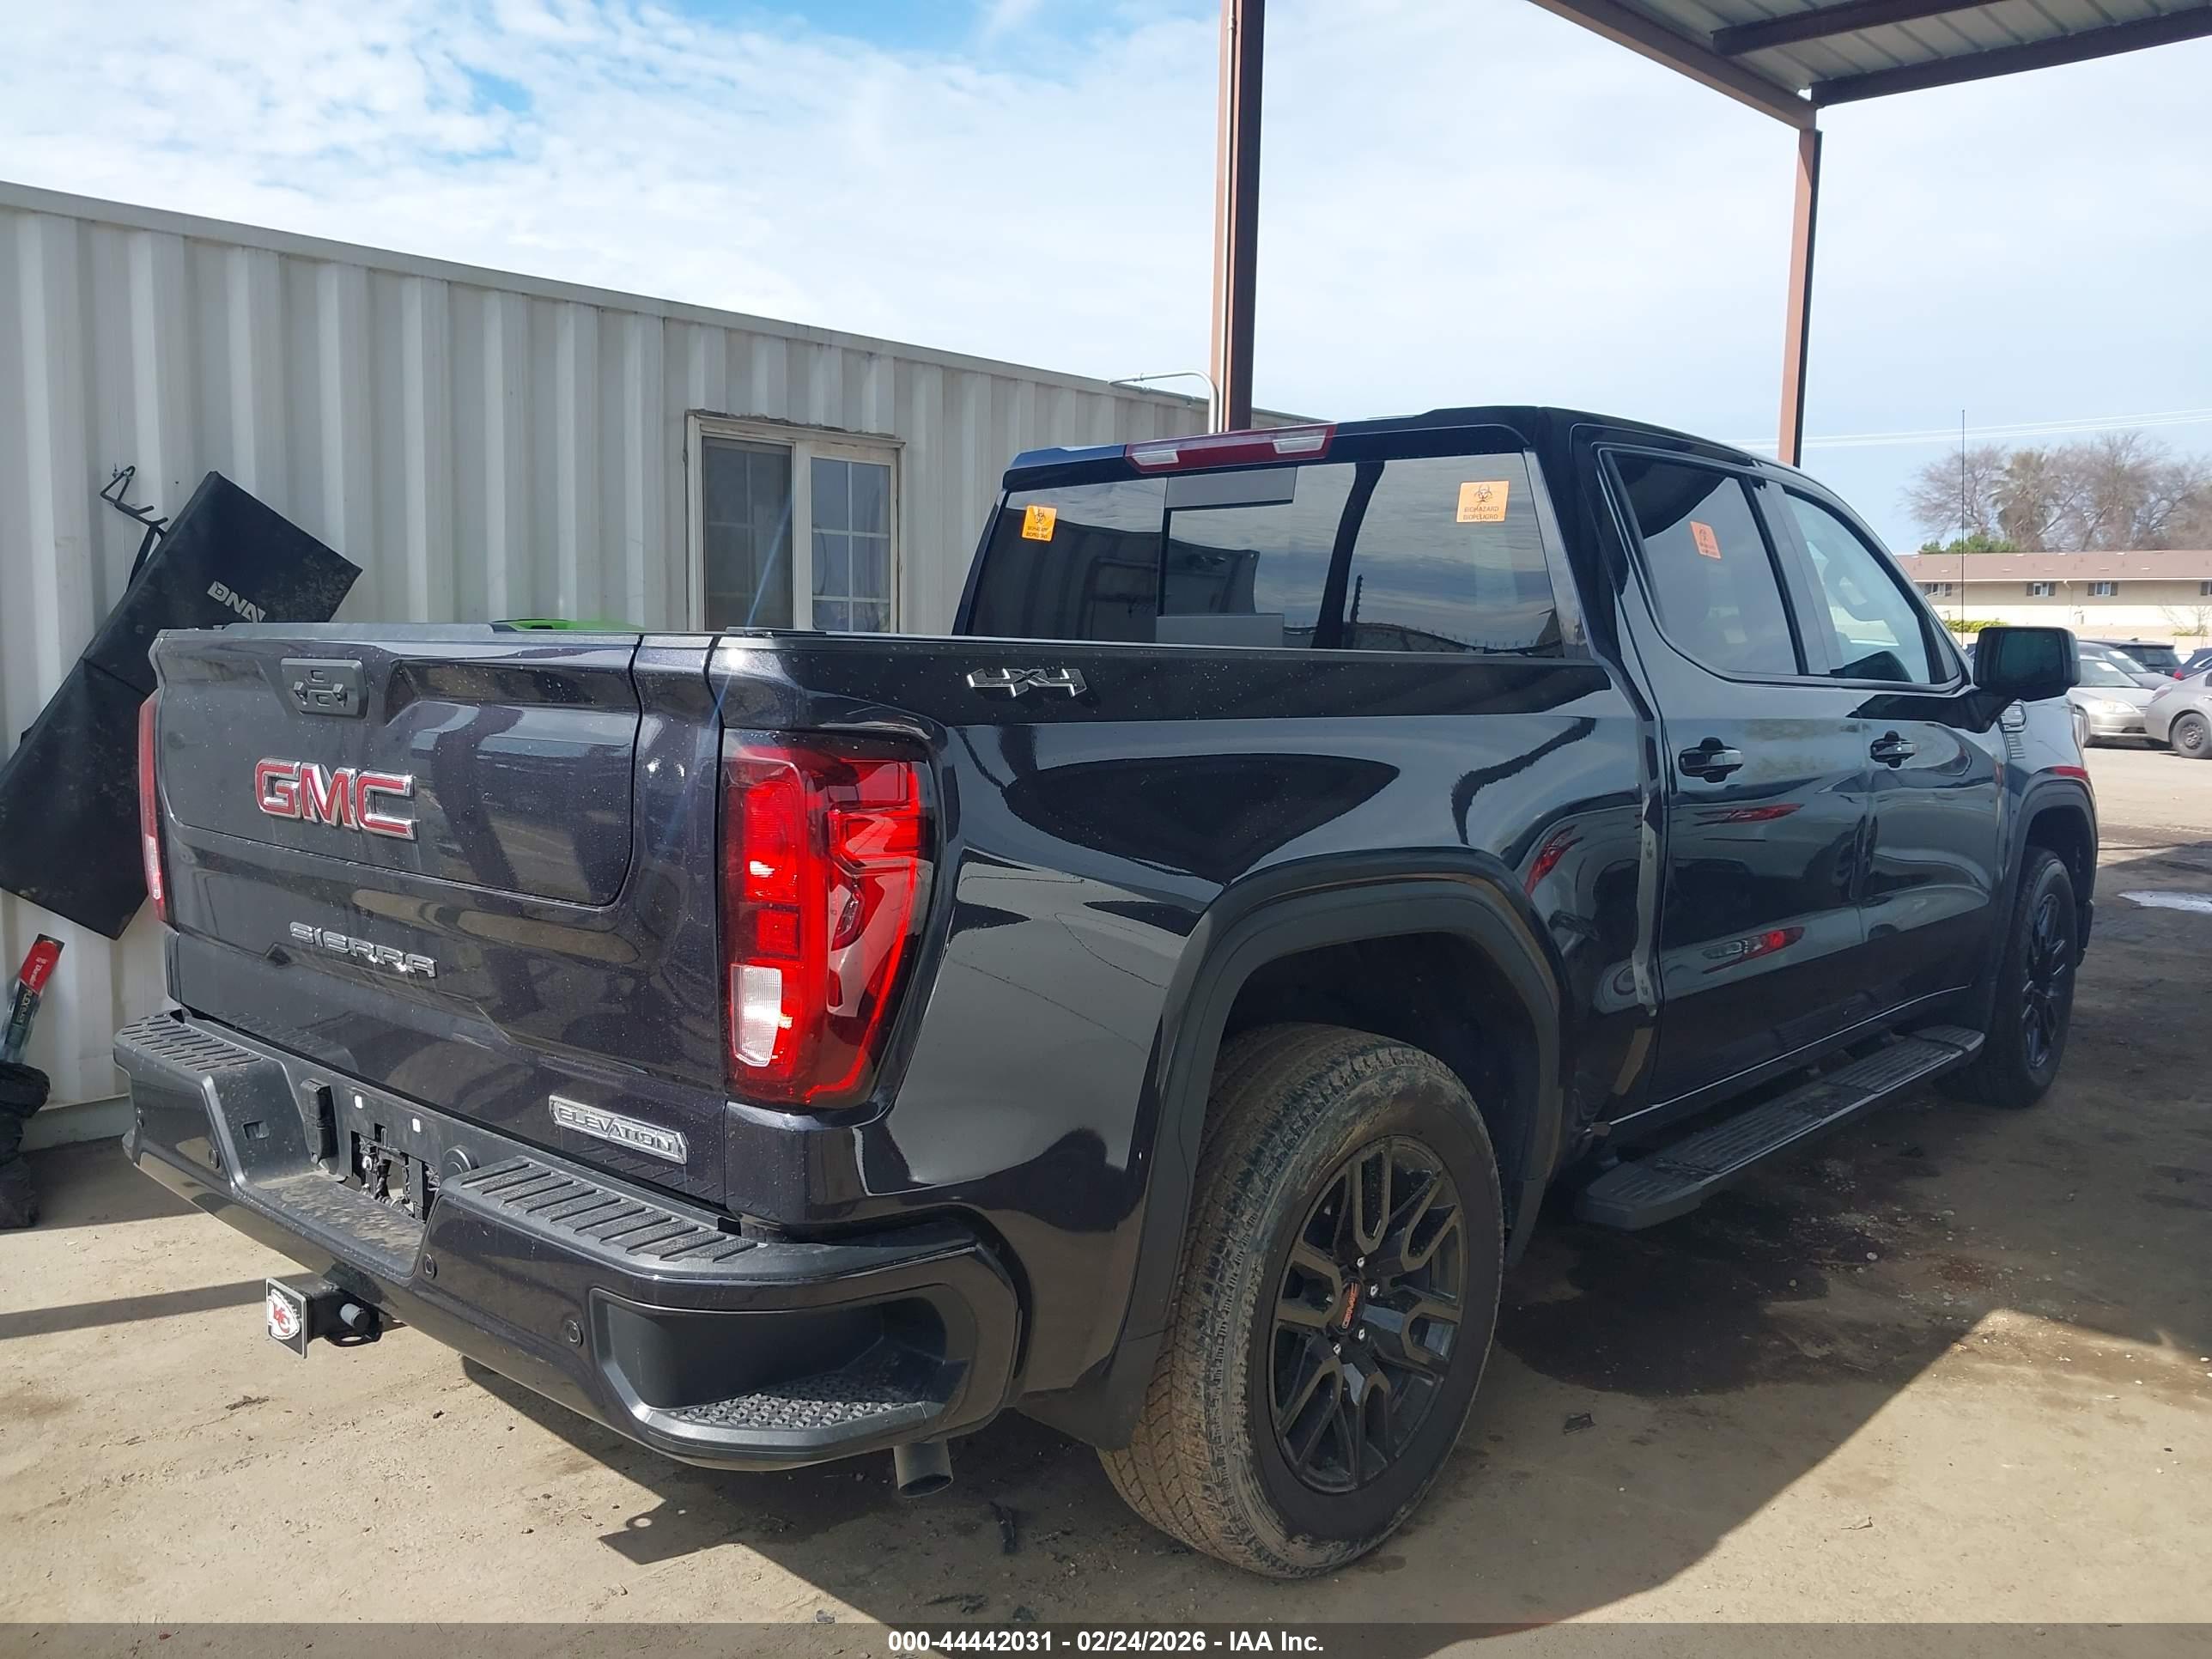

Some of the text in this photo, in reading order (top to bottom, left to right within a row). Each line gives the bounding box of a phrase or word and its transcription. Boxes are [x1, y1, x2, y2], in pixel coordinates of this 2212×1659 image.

[207, 580, 266, 623] DNA
[255, 757, 417, 842] GMC
[289, 921, 437, 978] SIERRA
[557, 1107, 674, 1152] ELEVATION
